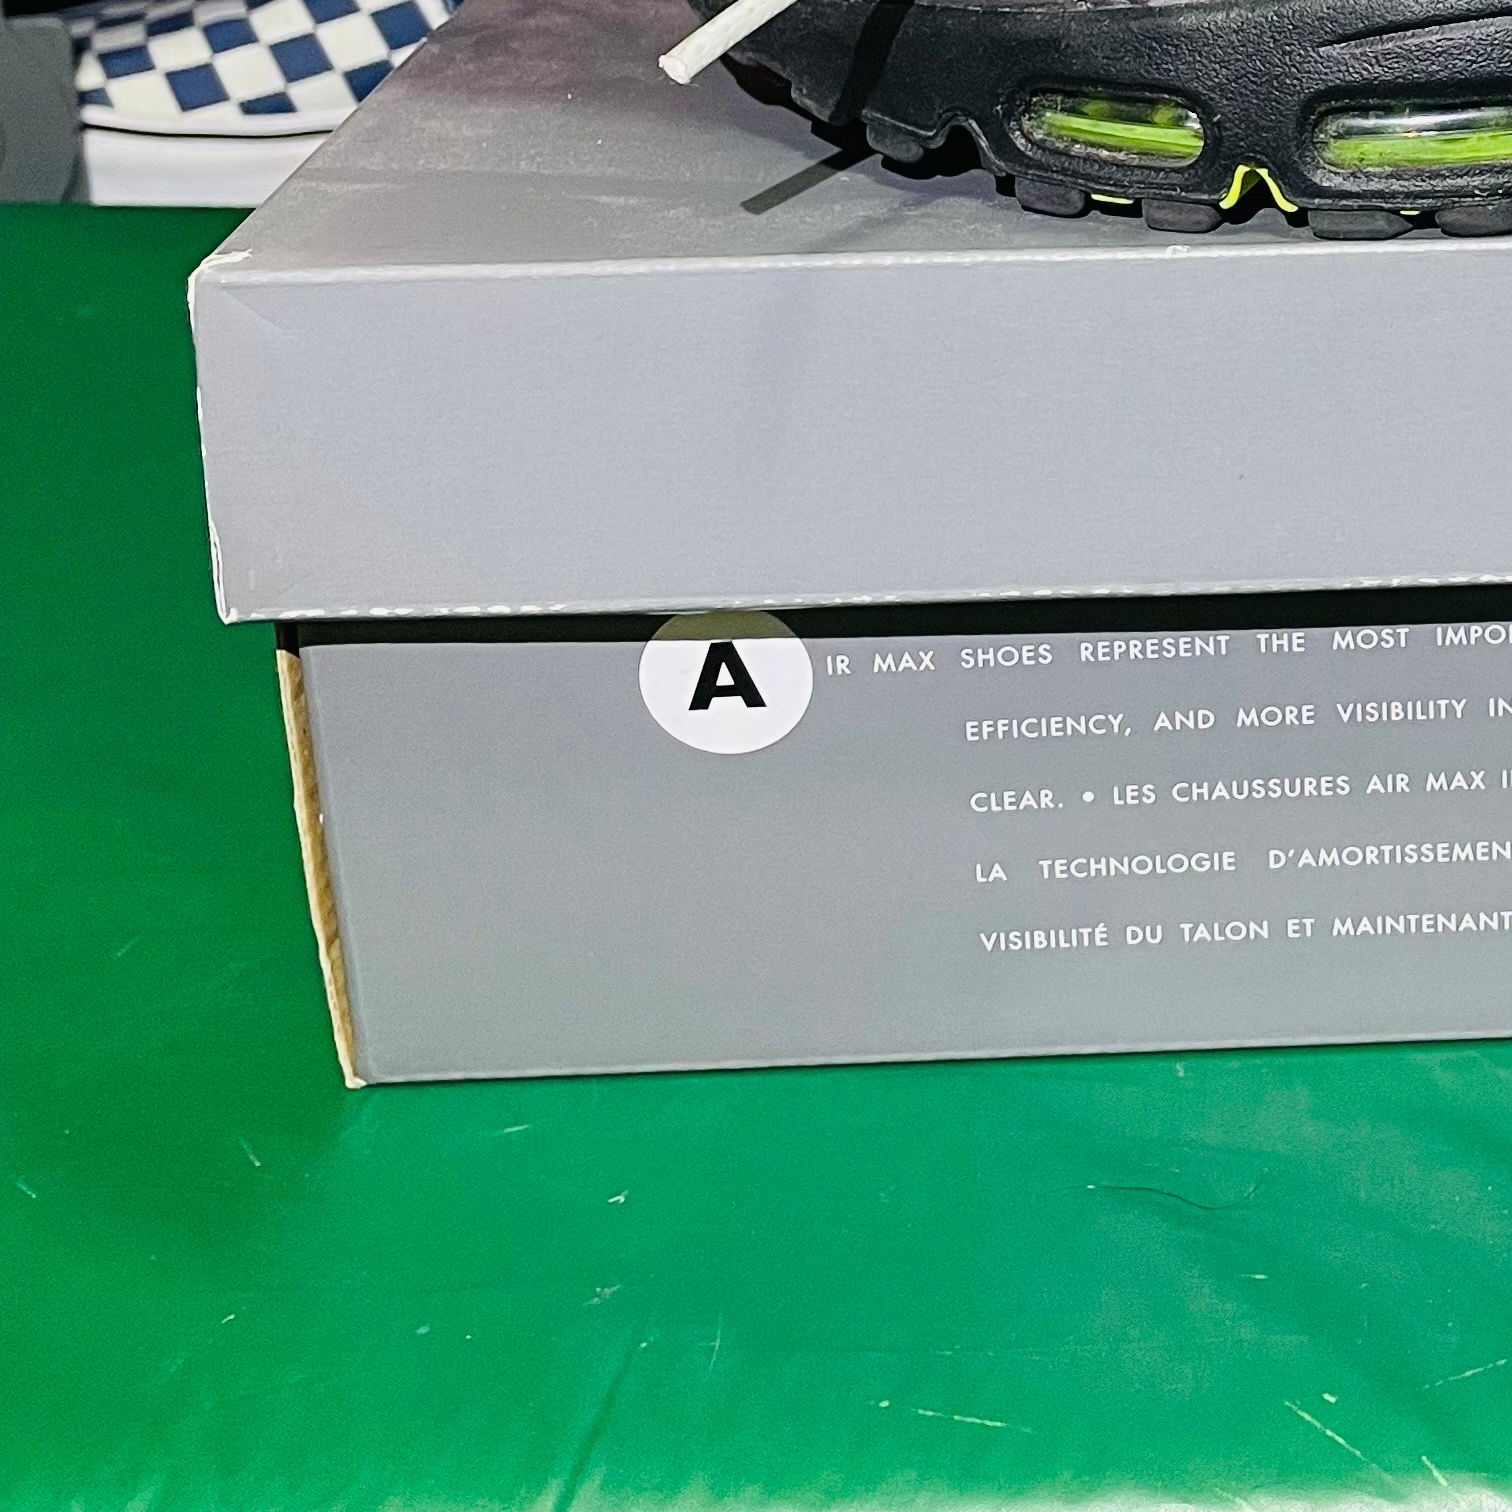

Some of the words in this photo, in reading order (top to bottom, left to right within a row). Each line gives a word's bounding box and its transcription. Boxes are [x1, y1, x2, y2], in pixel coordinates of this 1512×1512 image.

[688, 640, 767, 711] A
[826, 655, 851, 676] IR
[873, 650, 935, 673] MAX
[960, 644, 1053, 669] SHOES
[1080, 635, 1230, 662] REPRESENT
[1256, 632, 1305, 653] THE
[1332, 627, 1410, 650] MOST
[966, 713, 1131, 741] EFFICIENCY,
[1153, 709, 1215, 732] AND
[1236, 704, 1315, 728] MORE
[1336, 698, 1467, 723] VISIBILITY
[970, 789, 1064, 813] CLEAR.
[1113, 783, 1156, 805] LES
[1171, 775, 1350, 802] CHAUSSURES
[1366, 773, 1410, 794] AIR
[1426, 770, 1486, 792] MAX
[976, 862, 1008, 883] LA
[1038, 851, 1236, 879] TECHNOLOGIE
[979, 922, 1109, 952] VISIBILITÉ
[1126, 924, 1163, 945] DU
[1179, 920, 1269, 943] TALON
[1287, 918, 1315, 938] ET
